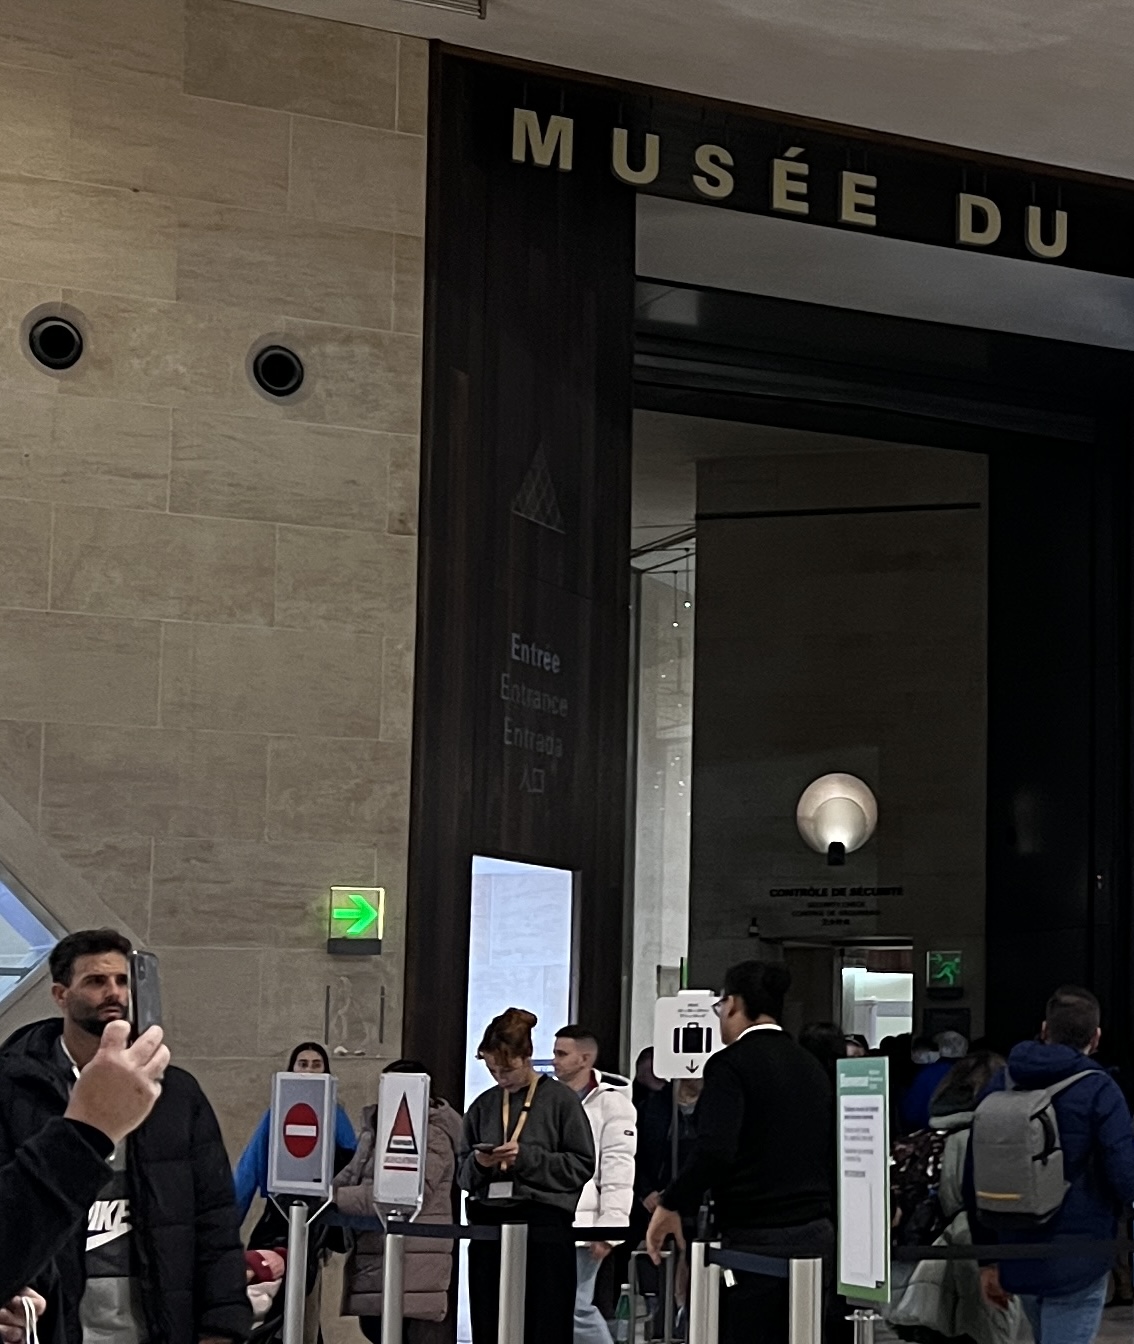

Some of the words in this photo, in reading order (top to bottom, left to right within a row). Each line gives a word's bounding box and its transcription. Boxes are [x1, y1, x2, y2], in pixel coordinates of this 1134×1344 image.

[512, 107, 877, 227] MUSÉE
[956, 192, 1068, 258] DU
[511, 632, 561, 674] Entrée
[501, 672, 569, 718] Entrance
[504, 716, 563, 758] Entrada
[831, 887, 847, 897] DE
